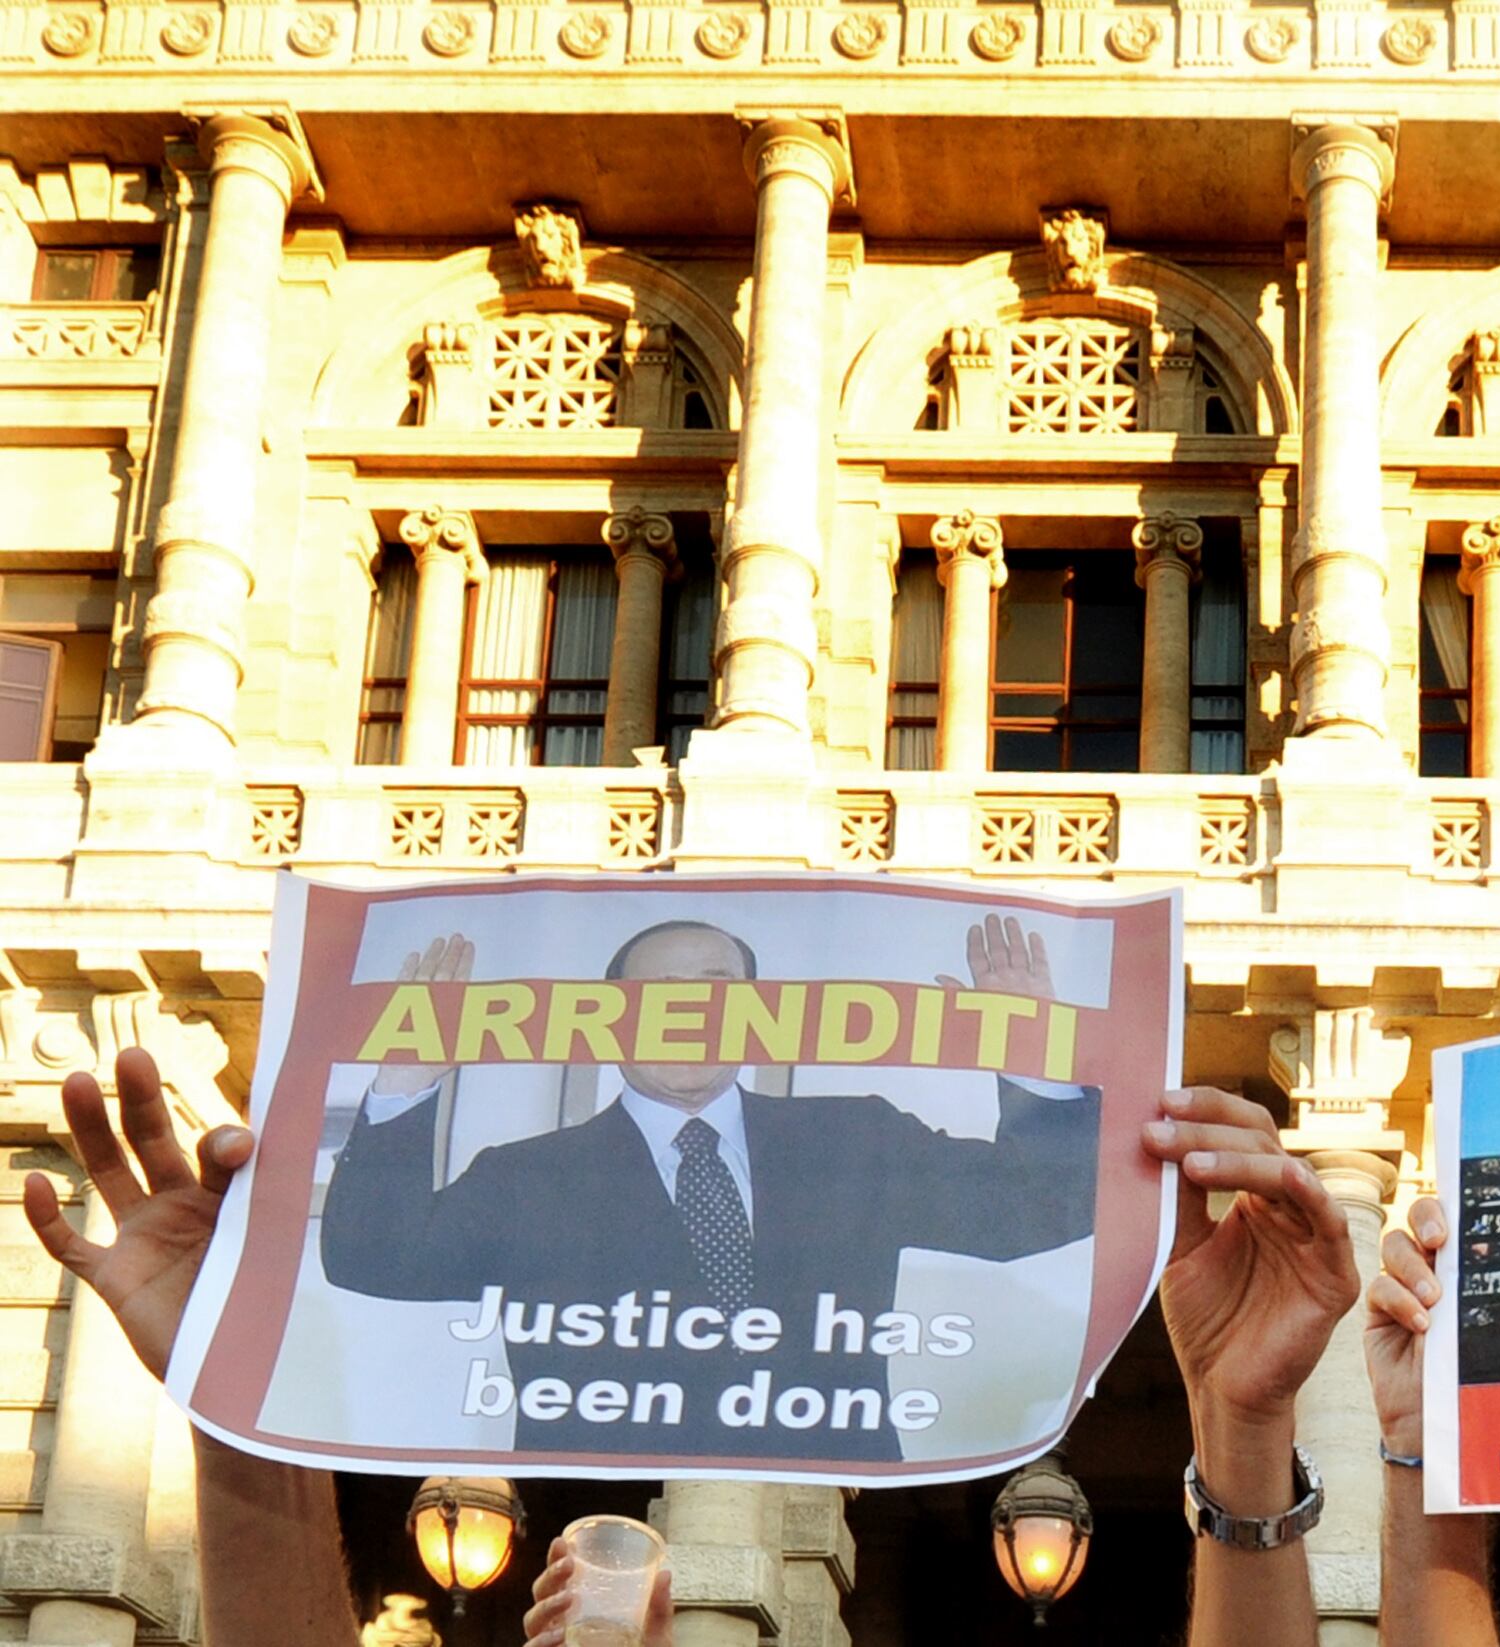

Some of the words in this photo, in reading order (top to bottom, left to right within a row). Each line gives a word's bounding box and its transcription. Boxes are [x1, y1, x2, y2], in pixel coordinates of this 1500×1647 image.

[356, 981, 1078, 1082] ARRENDITI
[448, 1285, 782, 1352] Justice
[813, 1293, 975, 1358] has
[461, 1358, 684, 1424] been
[715, 1369, 940, 1431] done
